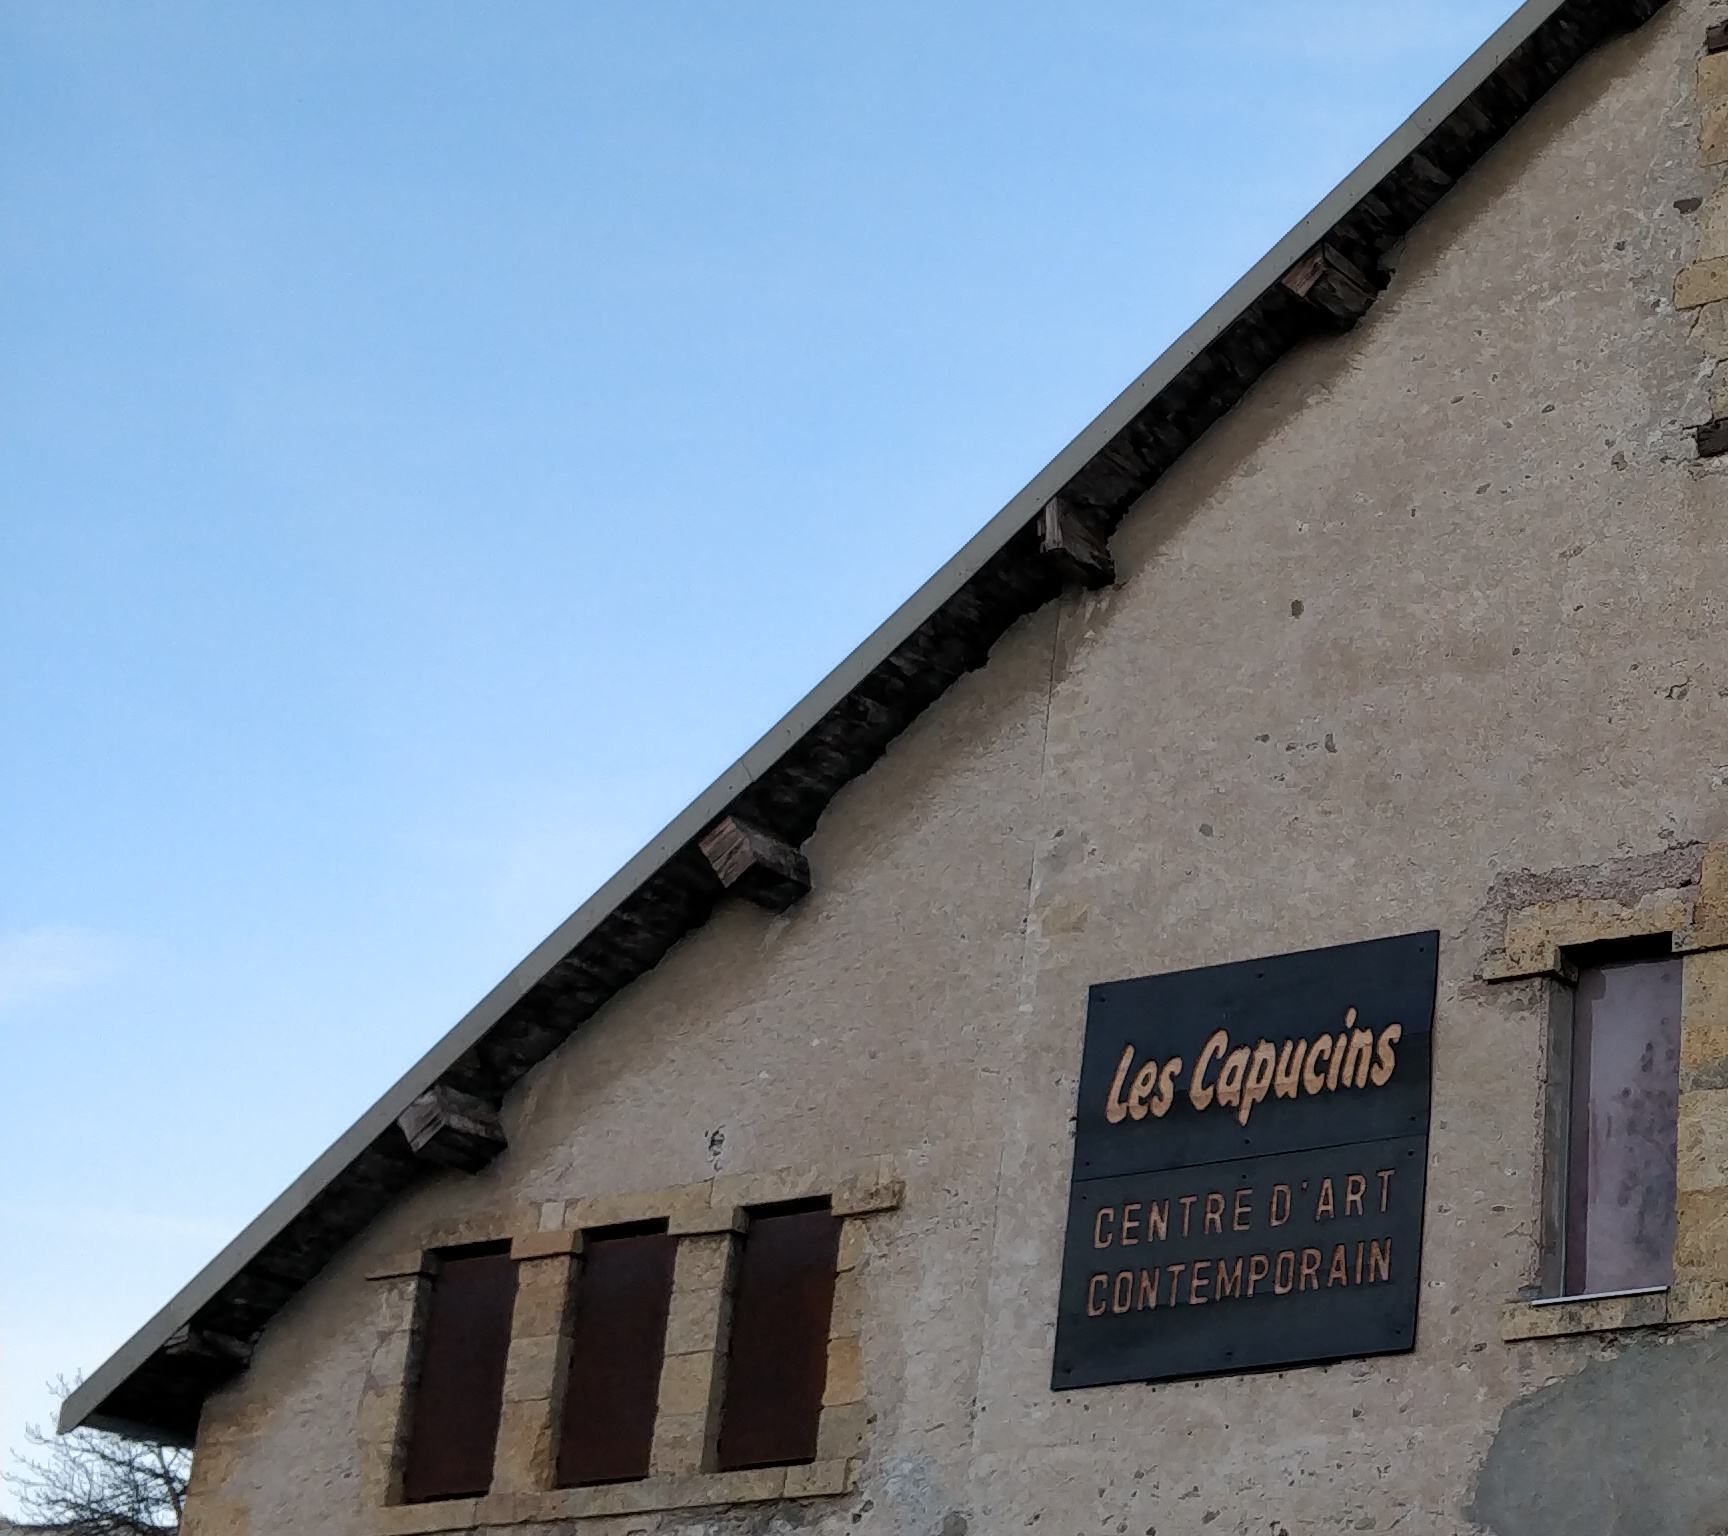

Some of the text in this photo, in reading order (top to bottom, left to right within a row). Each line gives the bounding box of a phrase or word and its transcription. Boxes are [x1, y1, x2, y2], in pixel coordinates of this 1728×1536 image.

[1106, 1006, 1402, 1126] Les Capucins
[1093, 1167, 1396, 1250] CENTRE D'ART
[1086, 1236, 1392, 1317] CONTEMPORAIN
